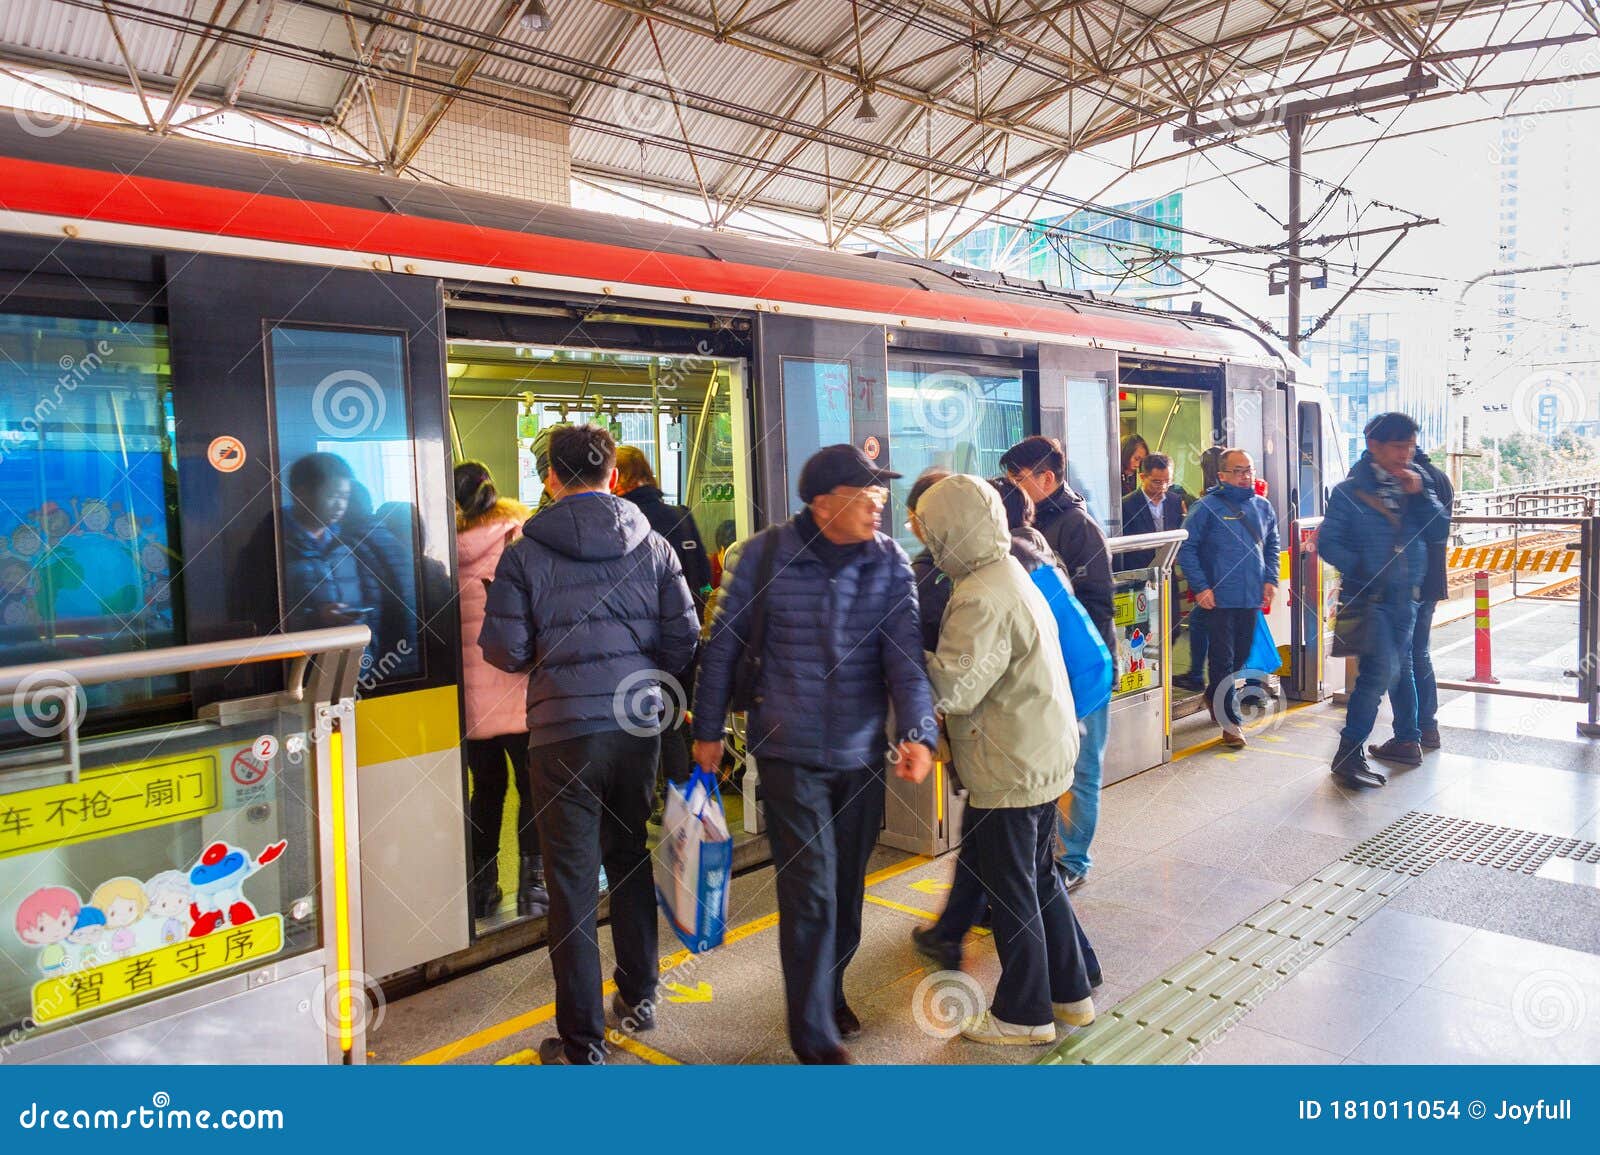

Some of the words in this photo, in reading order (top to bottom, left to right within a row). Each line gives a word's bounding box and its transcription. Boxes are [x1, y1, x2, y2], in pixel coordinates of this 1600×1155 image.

[260, 740, 271, 755] 2
[45, 772, 203, 828] 不抢一扇门
